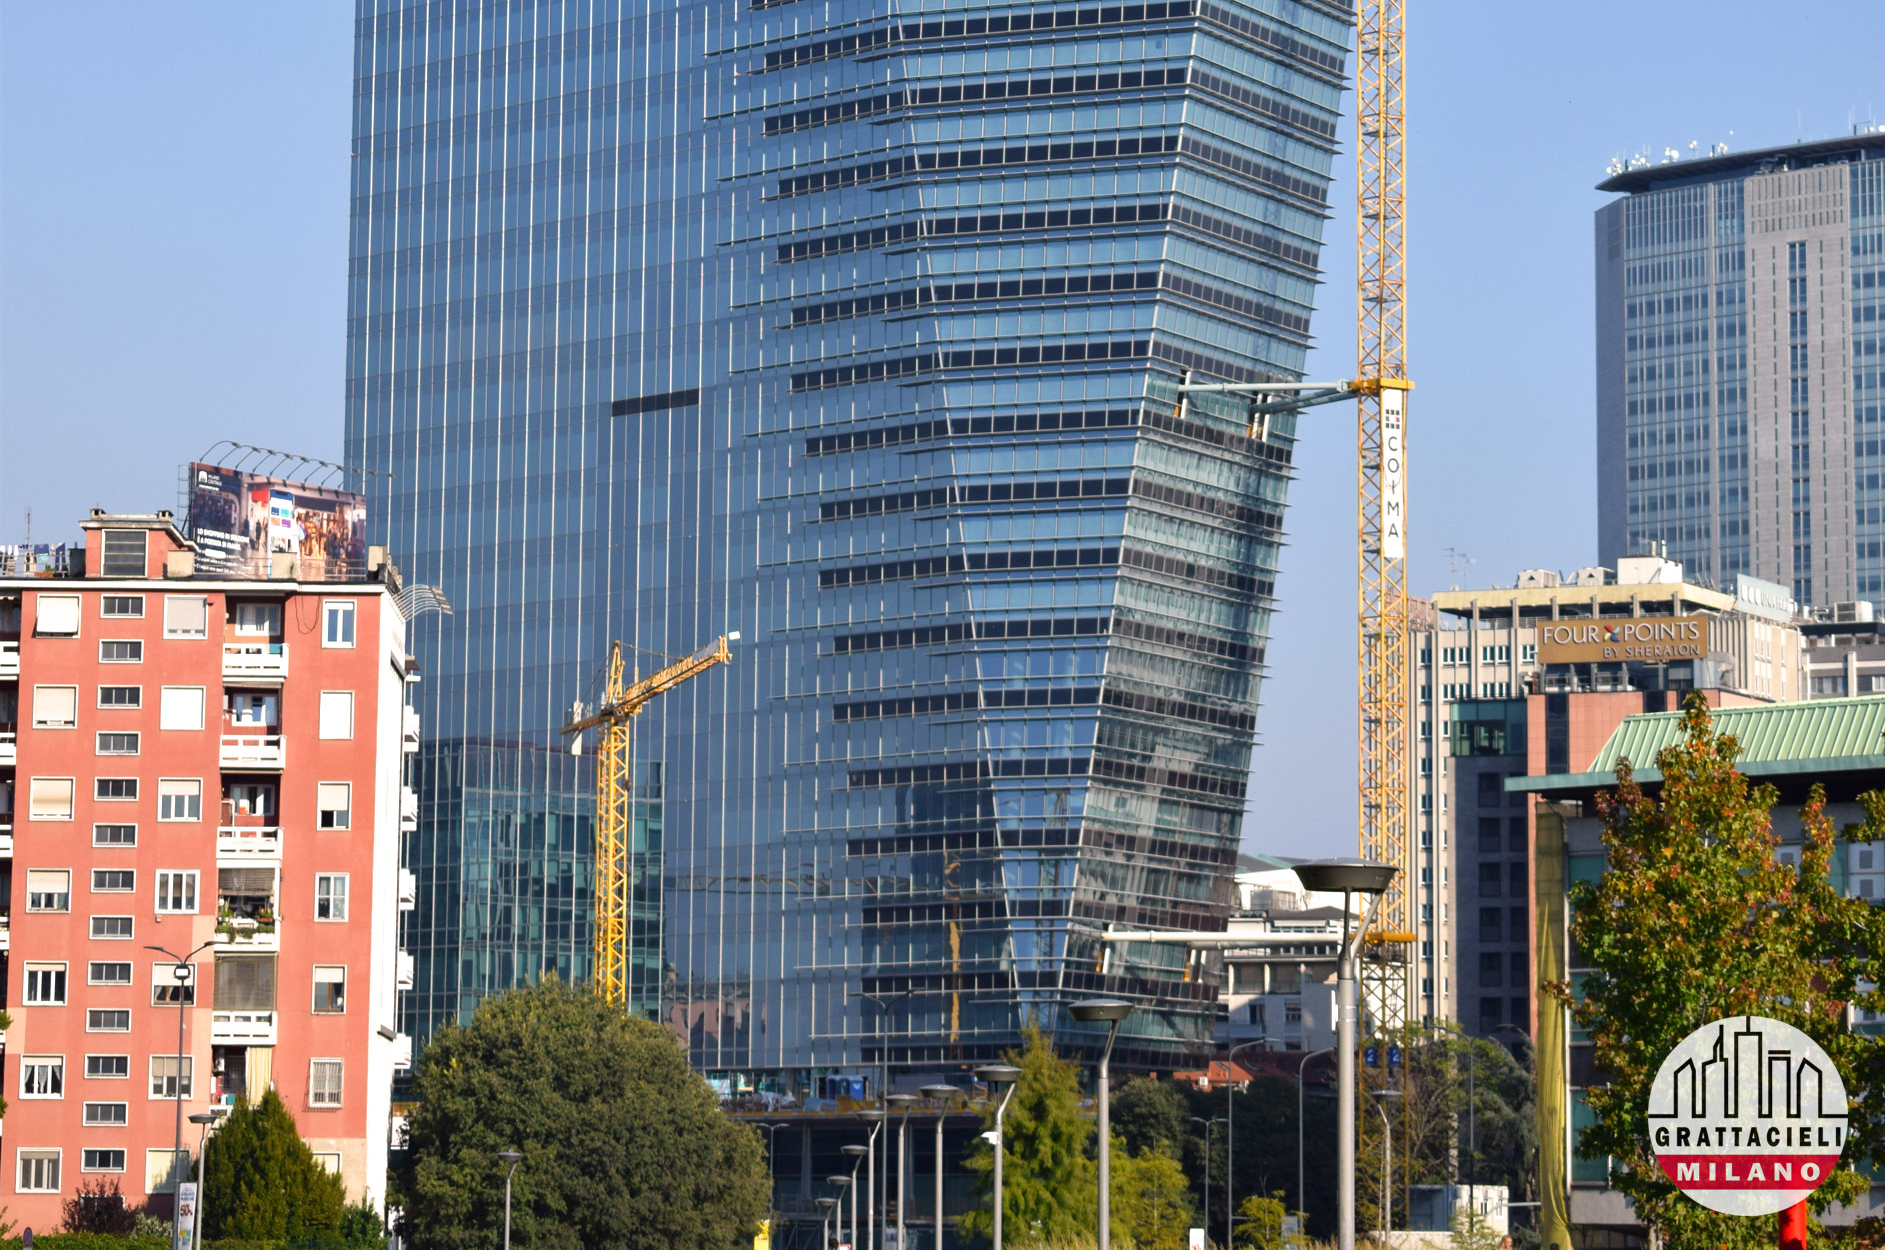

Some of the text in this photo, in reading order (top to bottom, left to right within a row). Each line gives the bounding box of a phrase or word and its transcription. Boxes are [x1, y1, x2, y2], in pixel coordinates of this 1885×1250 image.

[1388, 436, 1400, 538] COIMA
[203, 529, 225, 539] SHOPPING
[1543, 621, 1700, 645] FOUR POINTS
[1604, 644, 1699, 658] BY SHERATON
